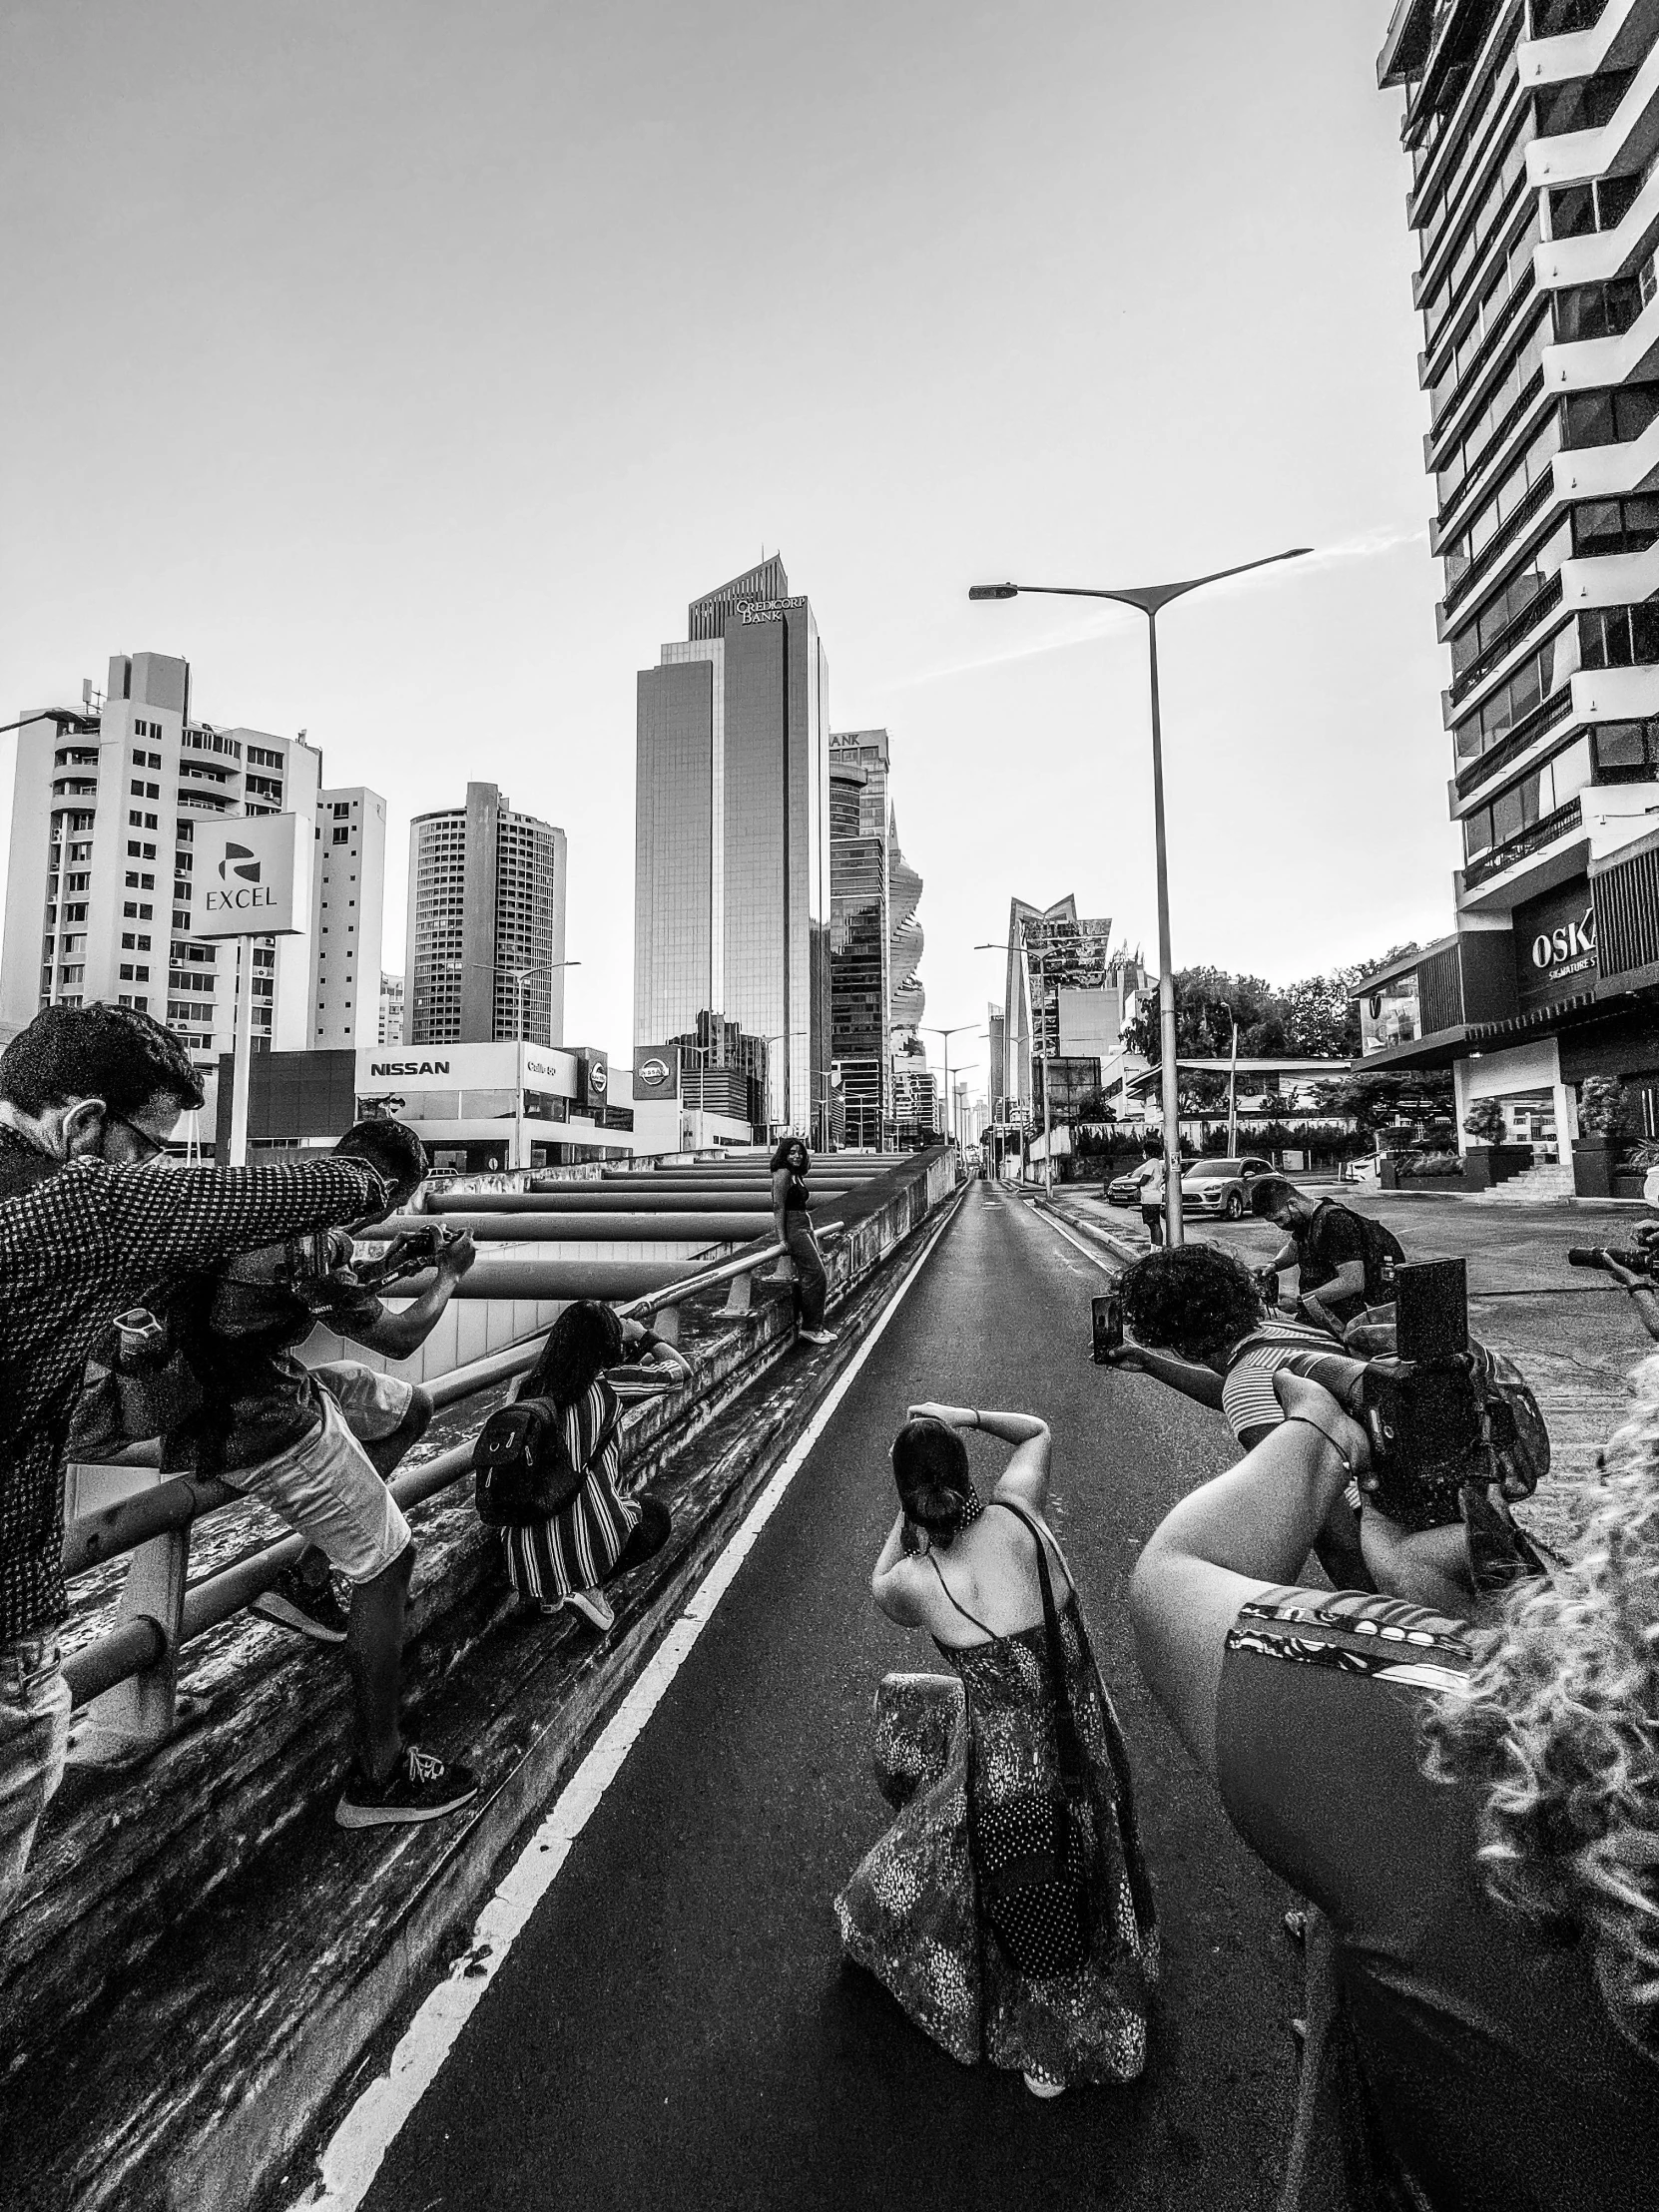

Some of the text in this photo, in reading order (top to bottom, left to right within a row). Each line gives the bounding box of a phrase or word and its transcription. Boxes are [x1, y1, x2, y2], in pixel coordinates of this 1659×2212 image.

[737, 598, 805, 614] CREDICORP
[743, 611, 782, 624] BANK
[829, 734, 860, 747] ANK
[206, 886, 277, 910] EXCEL
[1547, 956, 1589, 980] SIGNATURE
[370, 1061, 450, 1076] NISSAN
